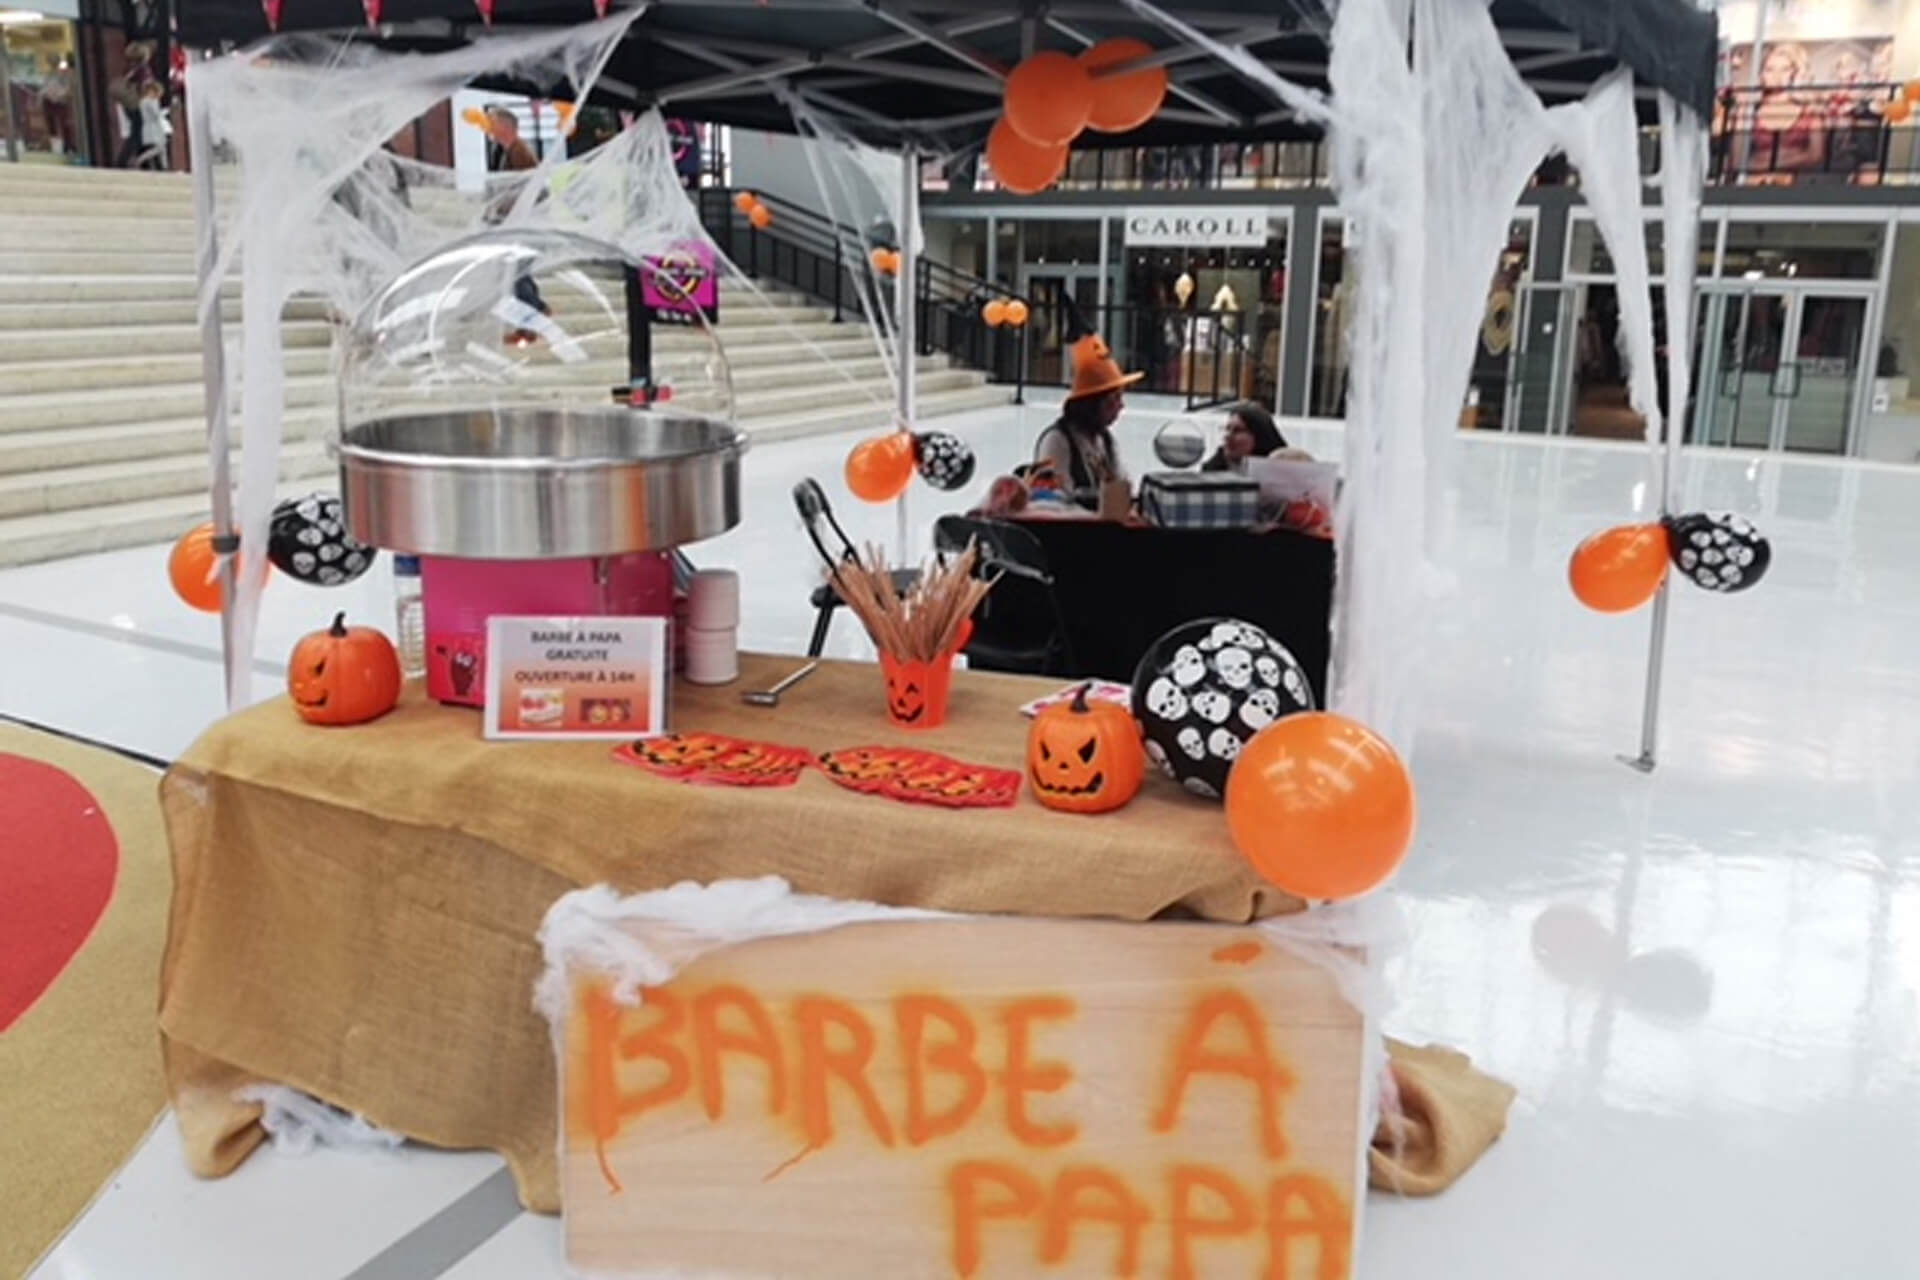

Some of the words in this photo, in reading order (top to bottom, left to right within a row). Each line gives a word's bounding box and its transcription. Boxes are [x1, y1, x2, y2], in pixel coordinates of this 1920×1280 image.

[1129, 217, 1262, 237] CAROLL
[532, 631, 573, 643] BARBE
[590, 631, 621, 643] PAPA
[546, 649, 608, 661] GRATUITE
[515, 671, 593, 683] OUVERTURE
[576, 984, 1080, 1172] BARBE
[948, 1160, 1353, 1280] PAPA
